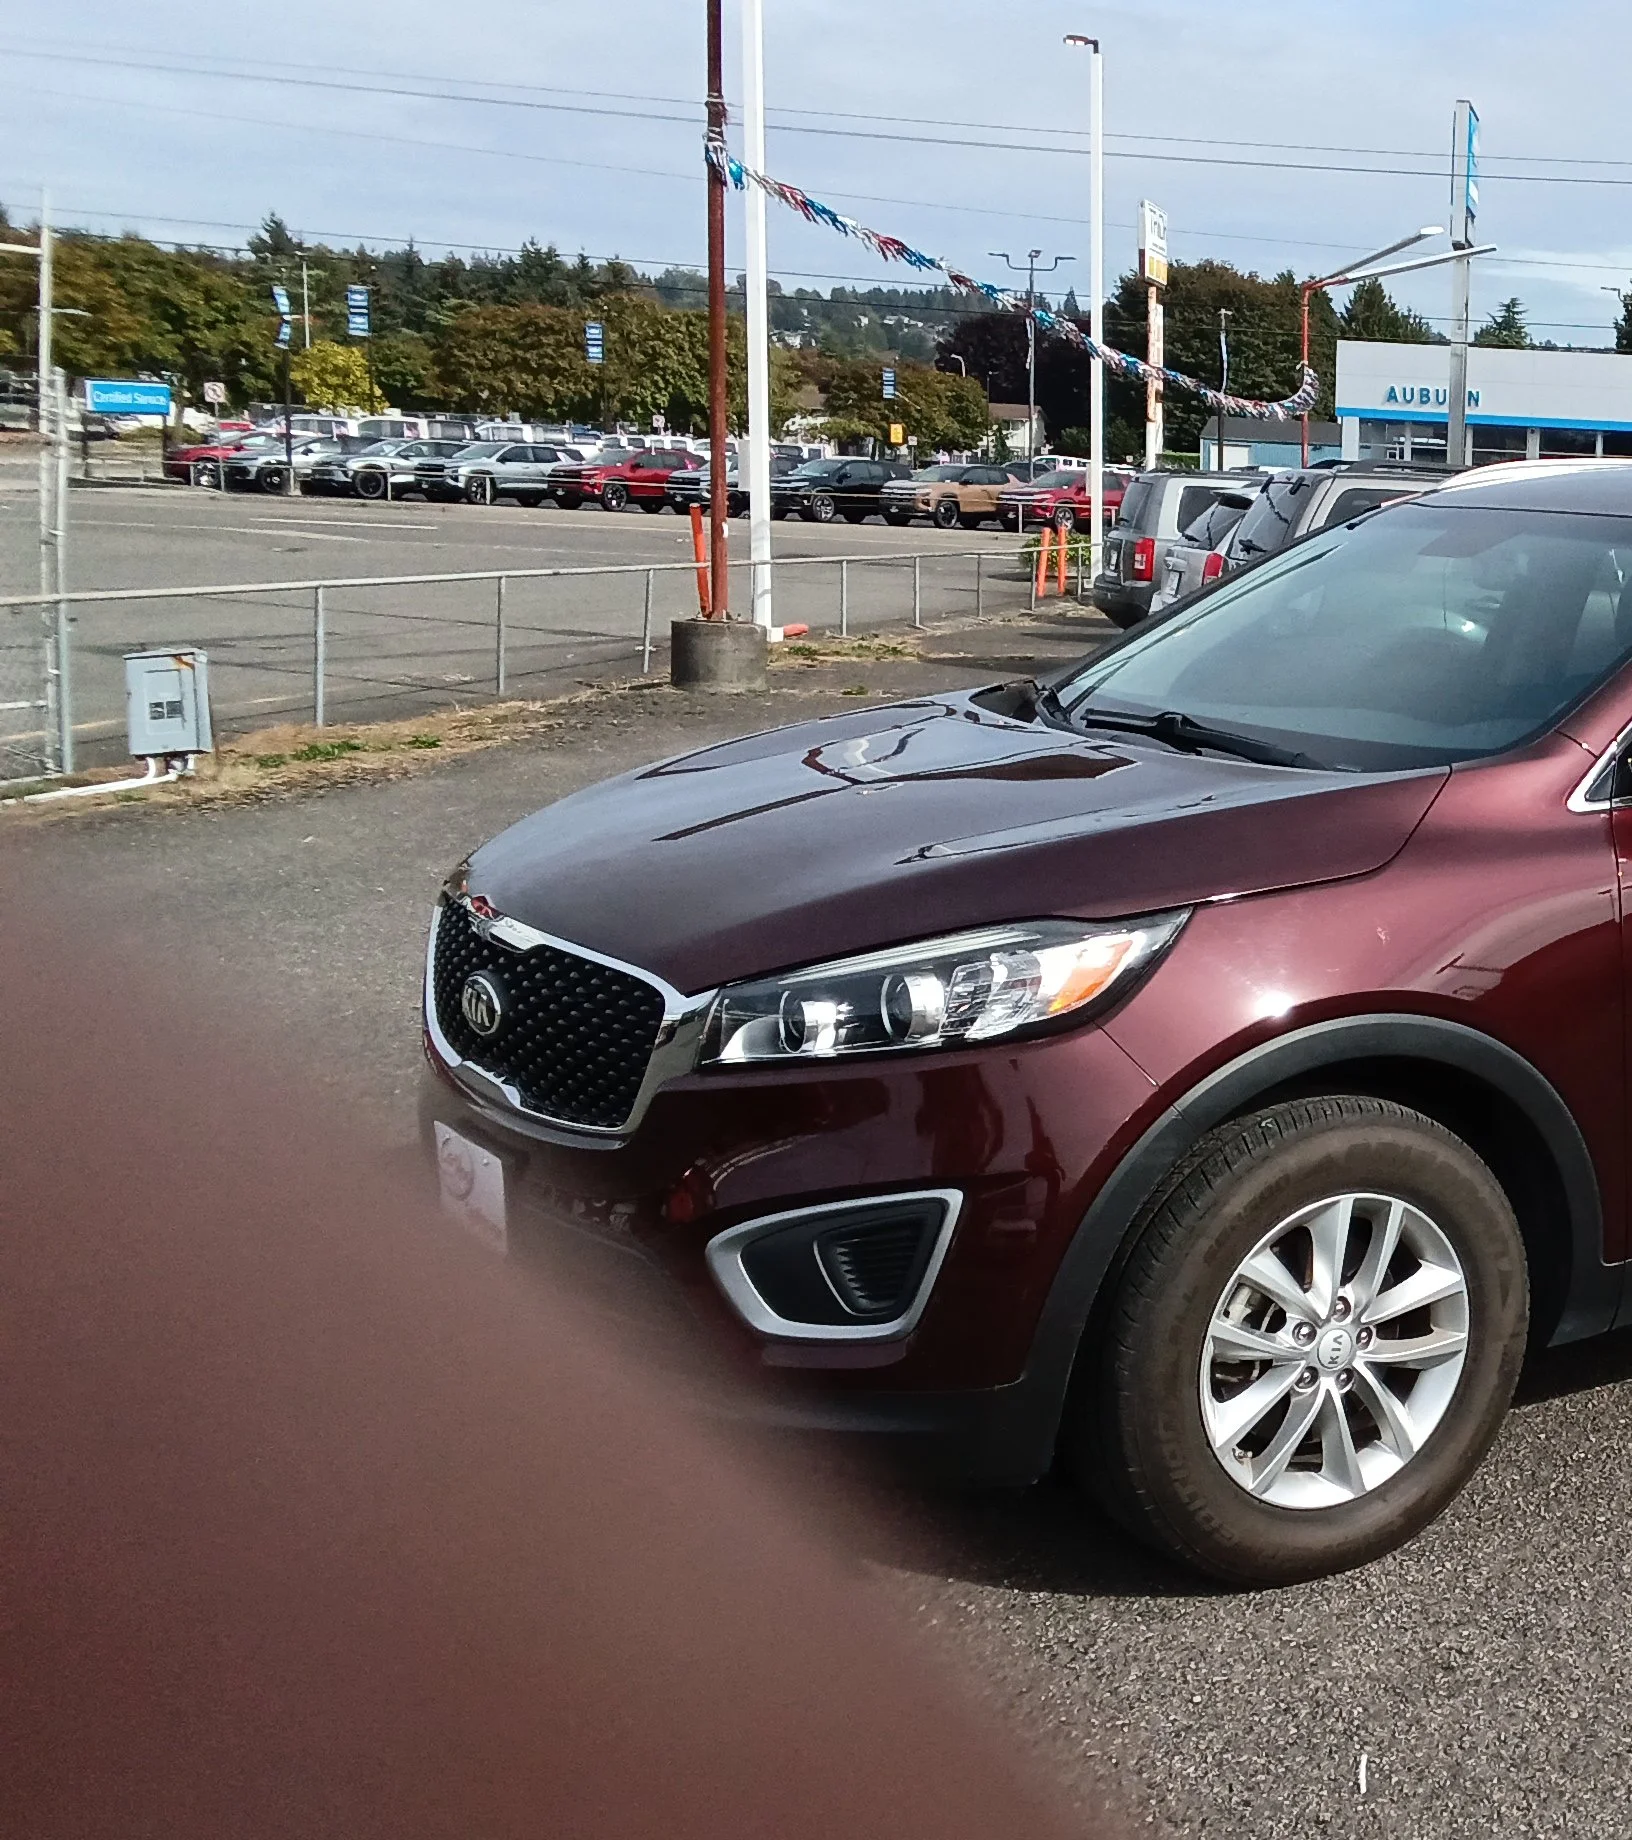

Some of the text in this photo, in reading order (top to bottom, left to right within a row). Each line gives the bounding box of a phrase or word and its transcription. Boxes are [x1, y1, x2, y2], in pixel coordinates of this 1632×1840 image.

[1386, 385, 1481, 408] AUBUN
[462, 985, 490, 1027] KIA
[1328, 1334, 1343, 1365] KIA
